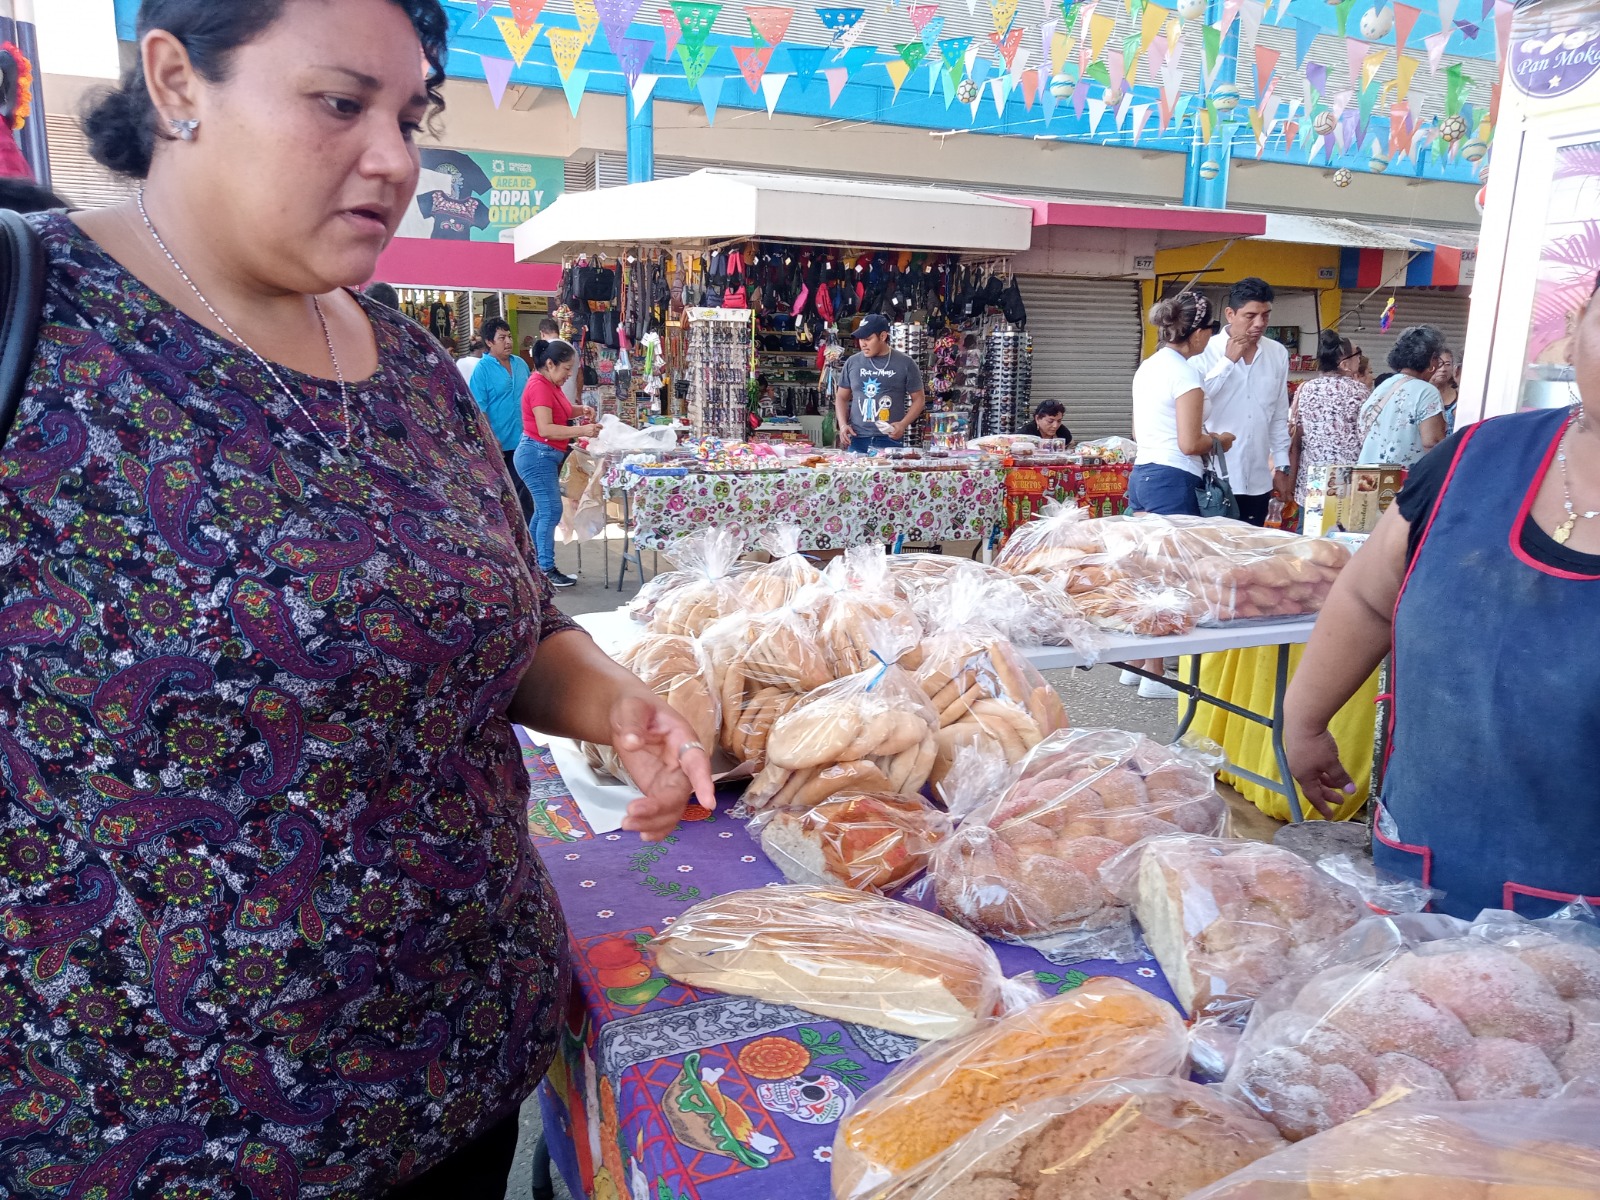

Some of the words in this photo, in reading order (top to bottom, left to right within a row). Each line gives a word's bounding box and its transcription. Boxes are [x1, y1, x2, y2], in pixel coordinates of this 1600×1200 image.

[1517, 58, 1550, 75] Pan
[520, 178, 532, 188] DE
[490, 190, 530, 206] ROPA
[533, 190, 545, 206] Y
